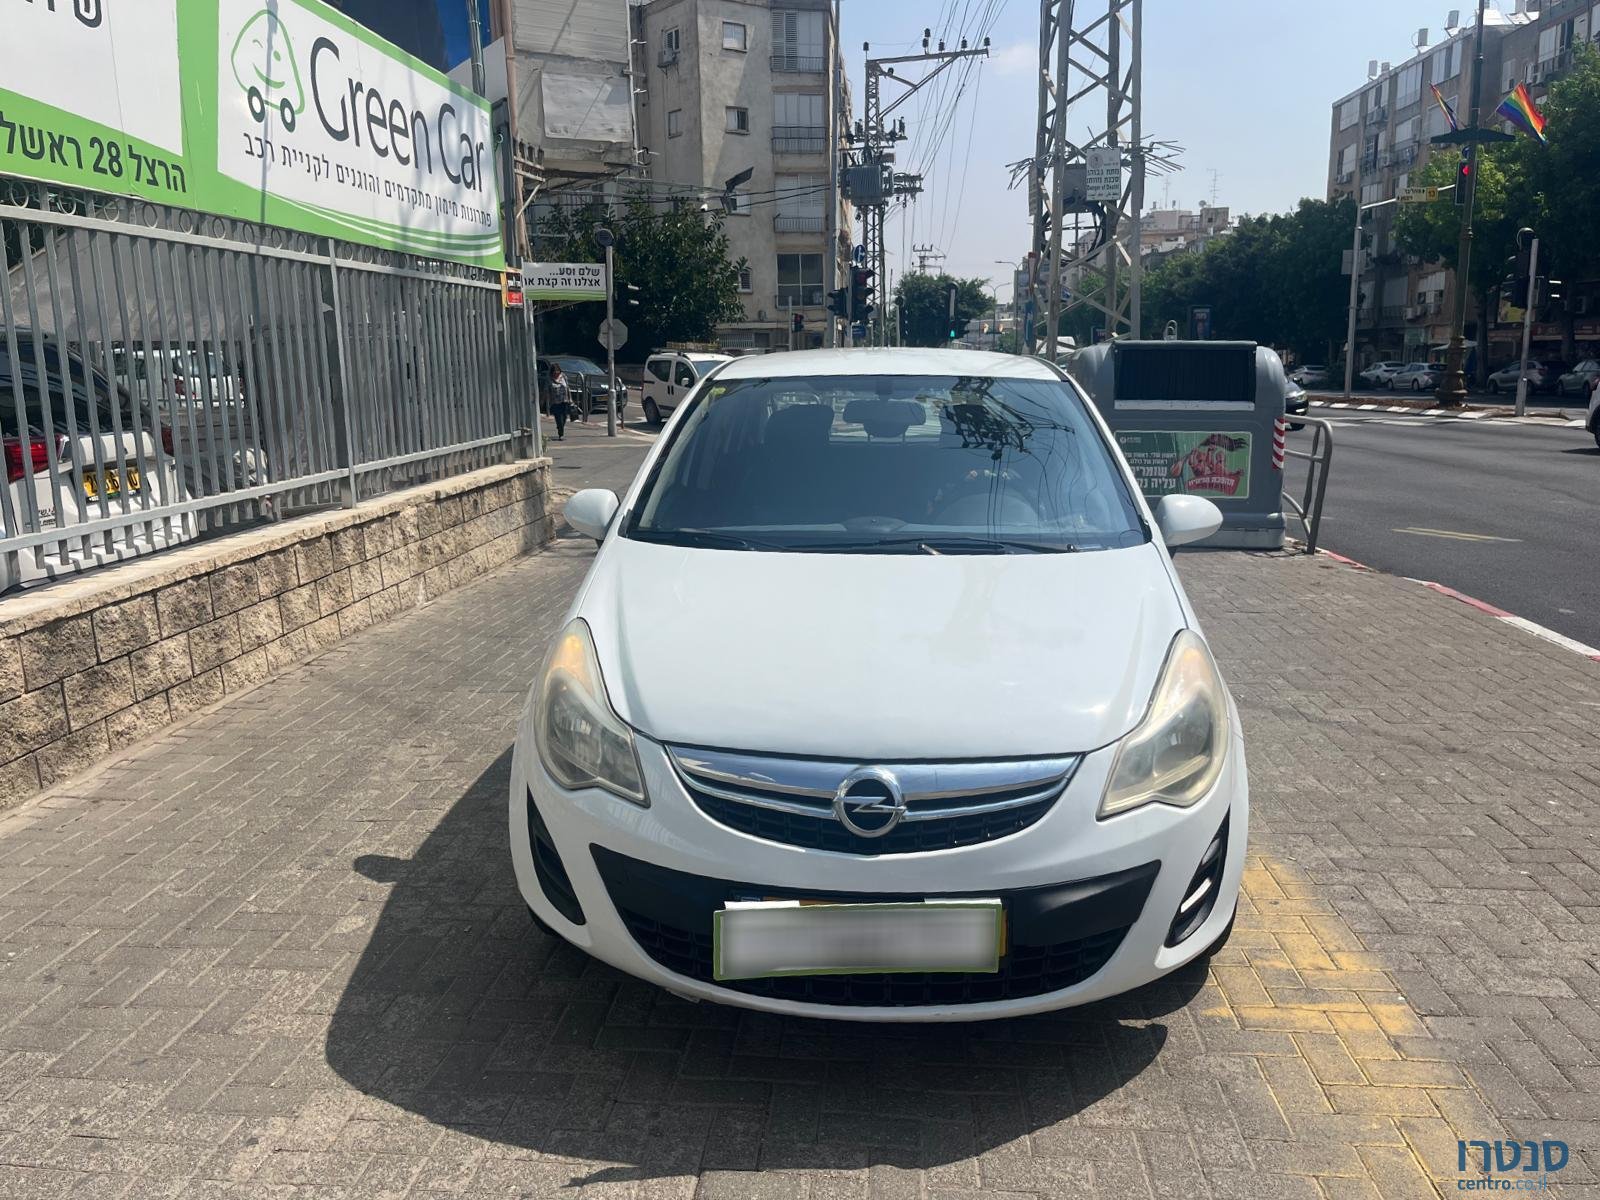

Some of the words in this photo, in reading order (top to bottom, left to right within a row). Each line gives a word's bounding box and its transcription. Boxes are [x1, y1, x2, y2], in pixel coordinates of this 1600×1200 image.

[310, 36, 433, 175] Green
[438, 103, 485, 192] Car
[89, 136, 124, 178] 28
[243, 132, 275, 162] רכב
[128, 144, 187, 193] הרצל
[281, 145, 329, 182] לקניית
[336, 163, 380, 195] והוגנים
[384, 180, 432, 210] מתקדמים
[435, 196, 458, 217] מימון
[460, 204, 492, 227] פתרונות
[537, 277, 558, 289] קצת
[549, 267, 576, 276] וסע...
[560, 277, 572, 286] זה
[574, 277, 601, 287] אצלנו
[578, 266, 600, 277] שלם
